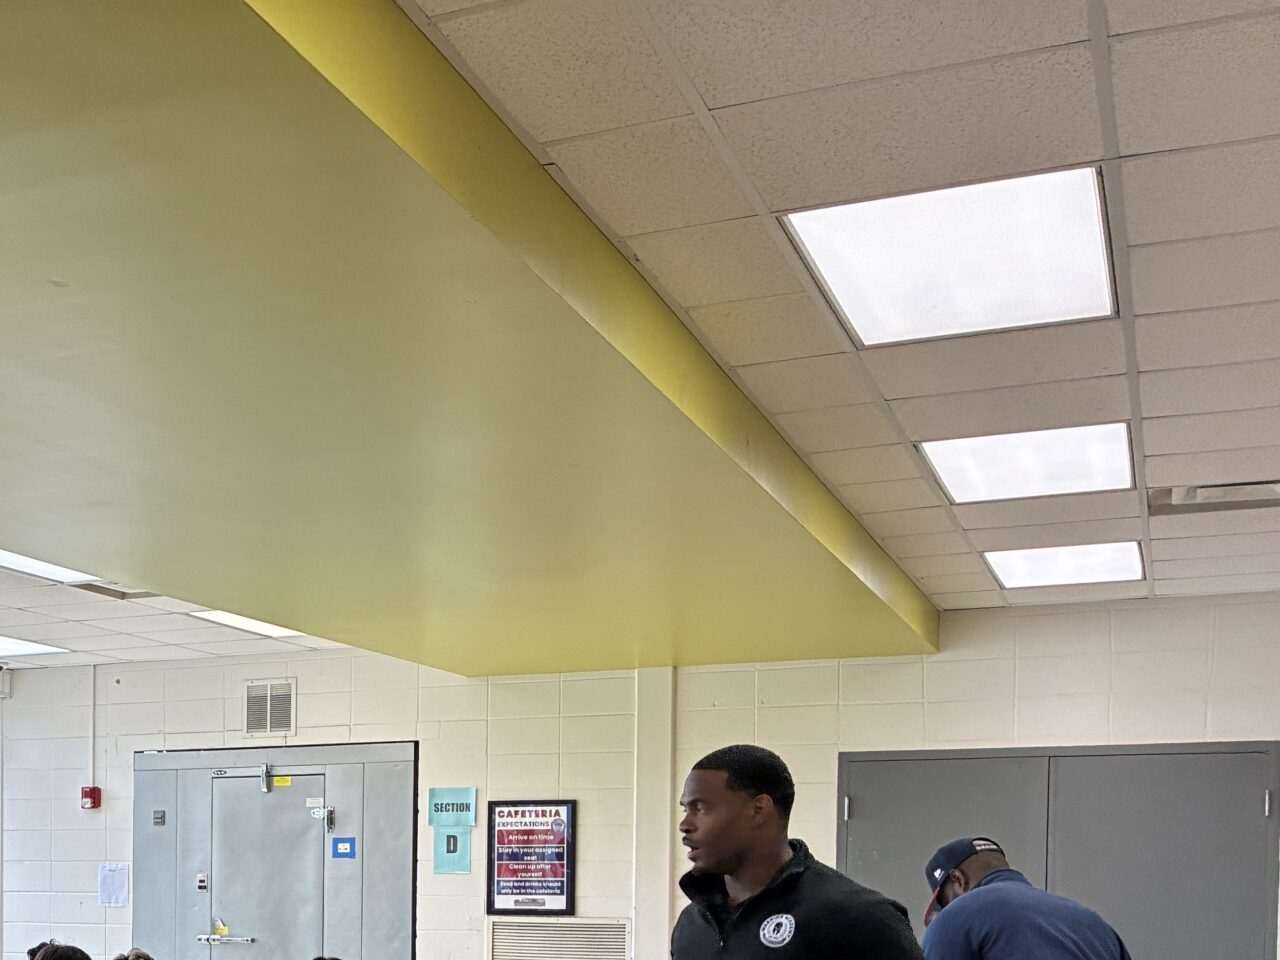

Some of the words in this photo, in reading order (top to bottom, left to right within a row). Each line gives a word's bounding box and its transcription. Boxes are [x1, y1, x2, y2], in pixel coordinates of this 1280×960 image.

[433, 802, 471, 813] SECTION
[497, 809, 561, 819] CAFETERIA
[446, 834, 458, 854] D
